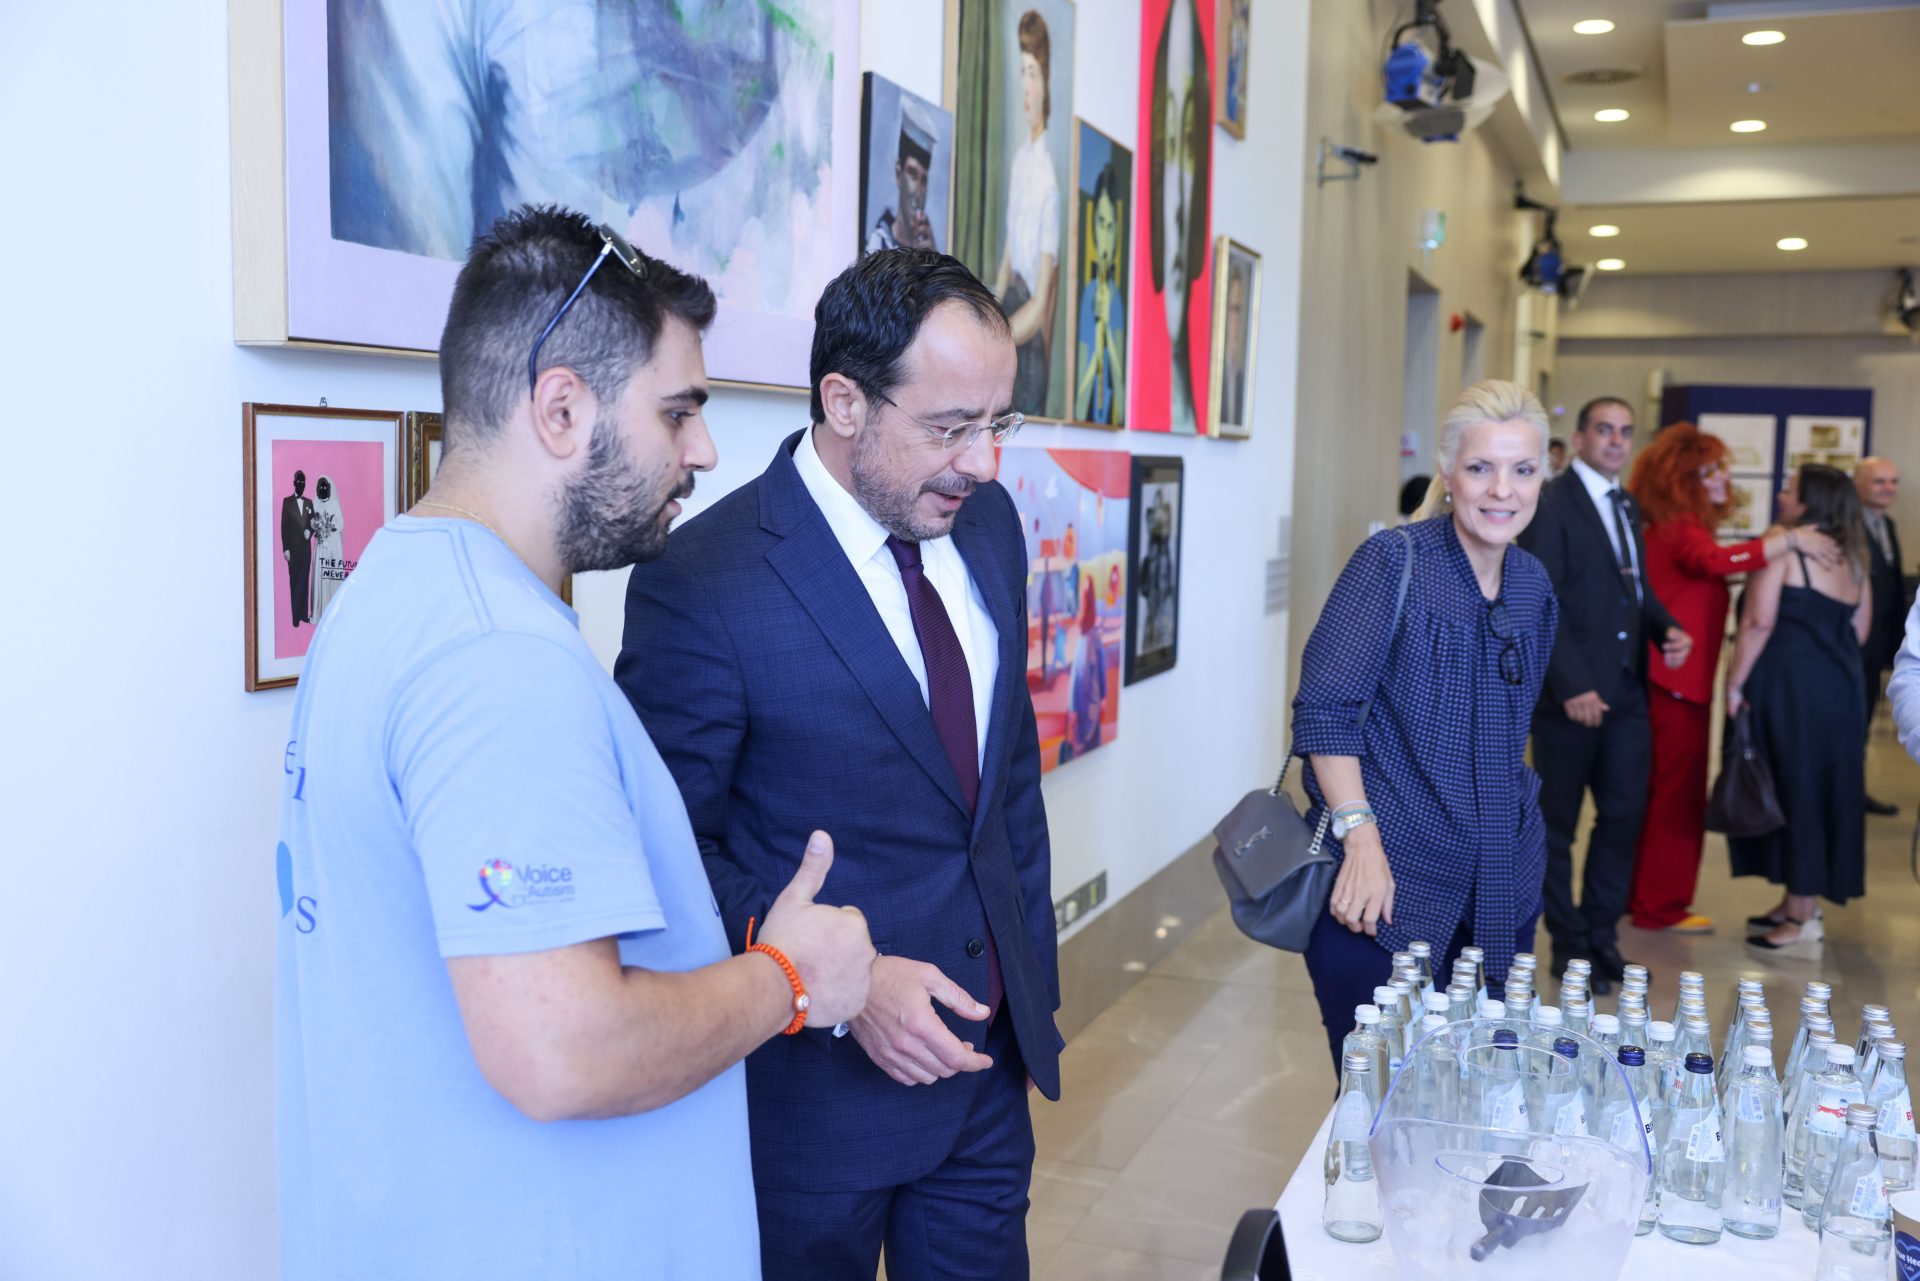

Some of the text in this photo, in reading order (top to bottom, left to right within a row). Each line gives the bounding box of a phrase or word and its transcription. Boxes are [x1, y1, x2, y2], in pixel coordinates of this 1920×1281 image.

[319, 558, 336, 567] THE
[516, 864, 573, 884] Voice
[528, 885, 575, 898] Autism
